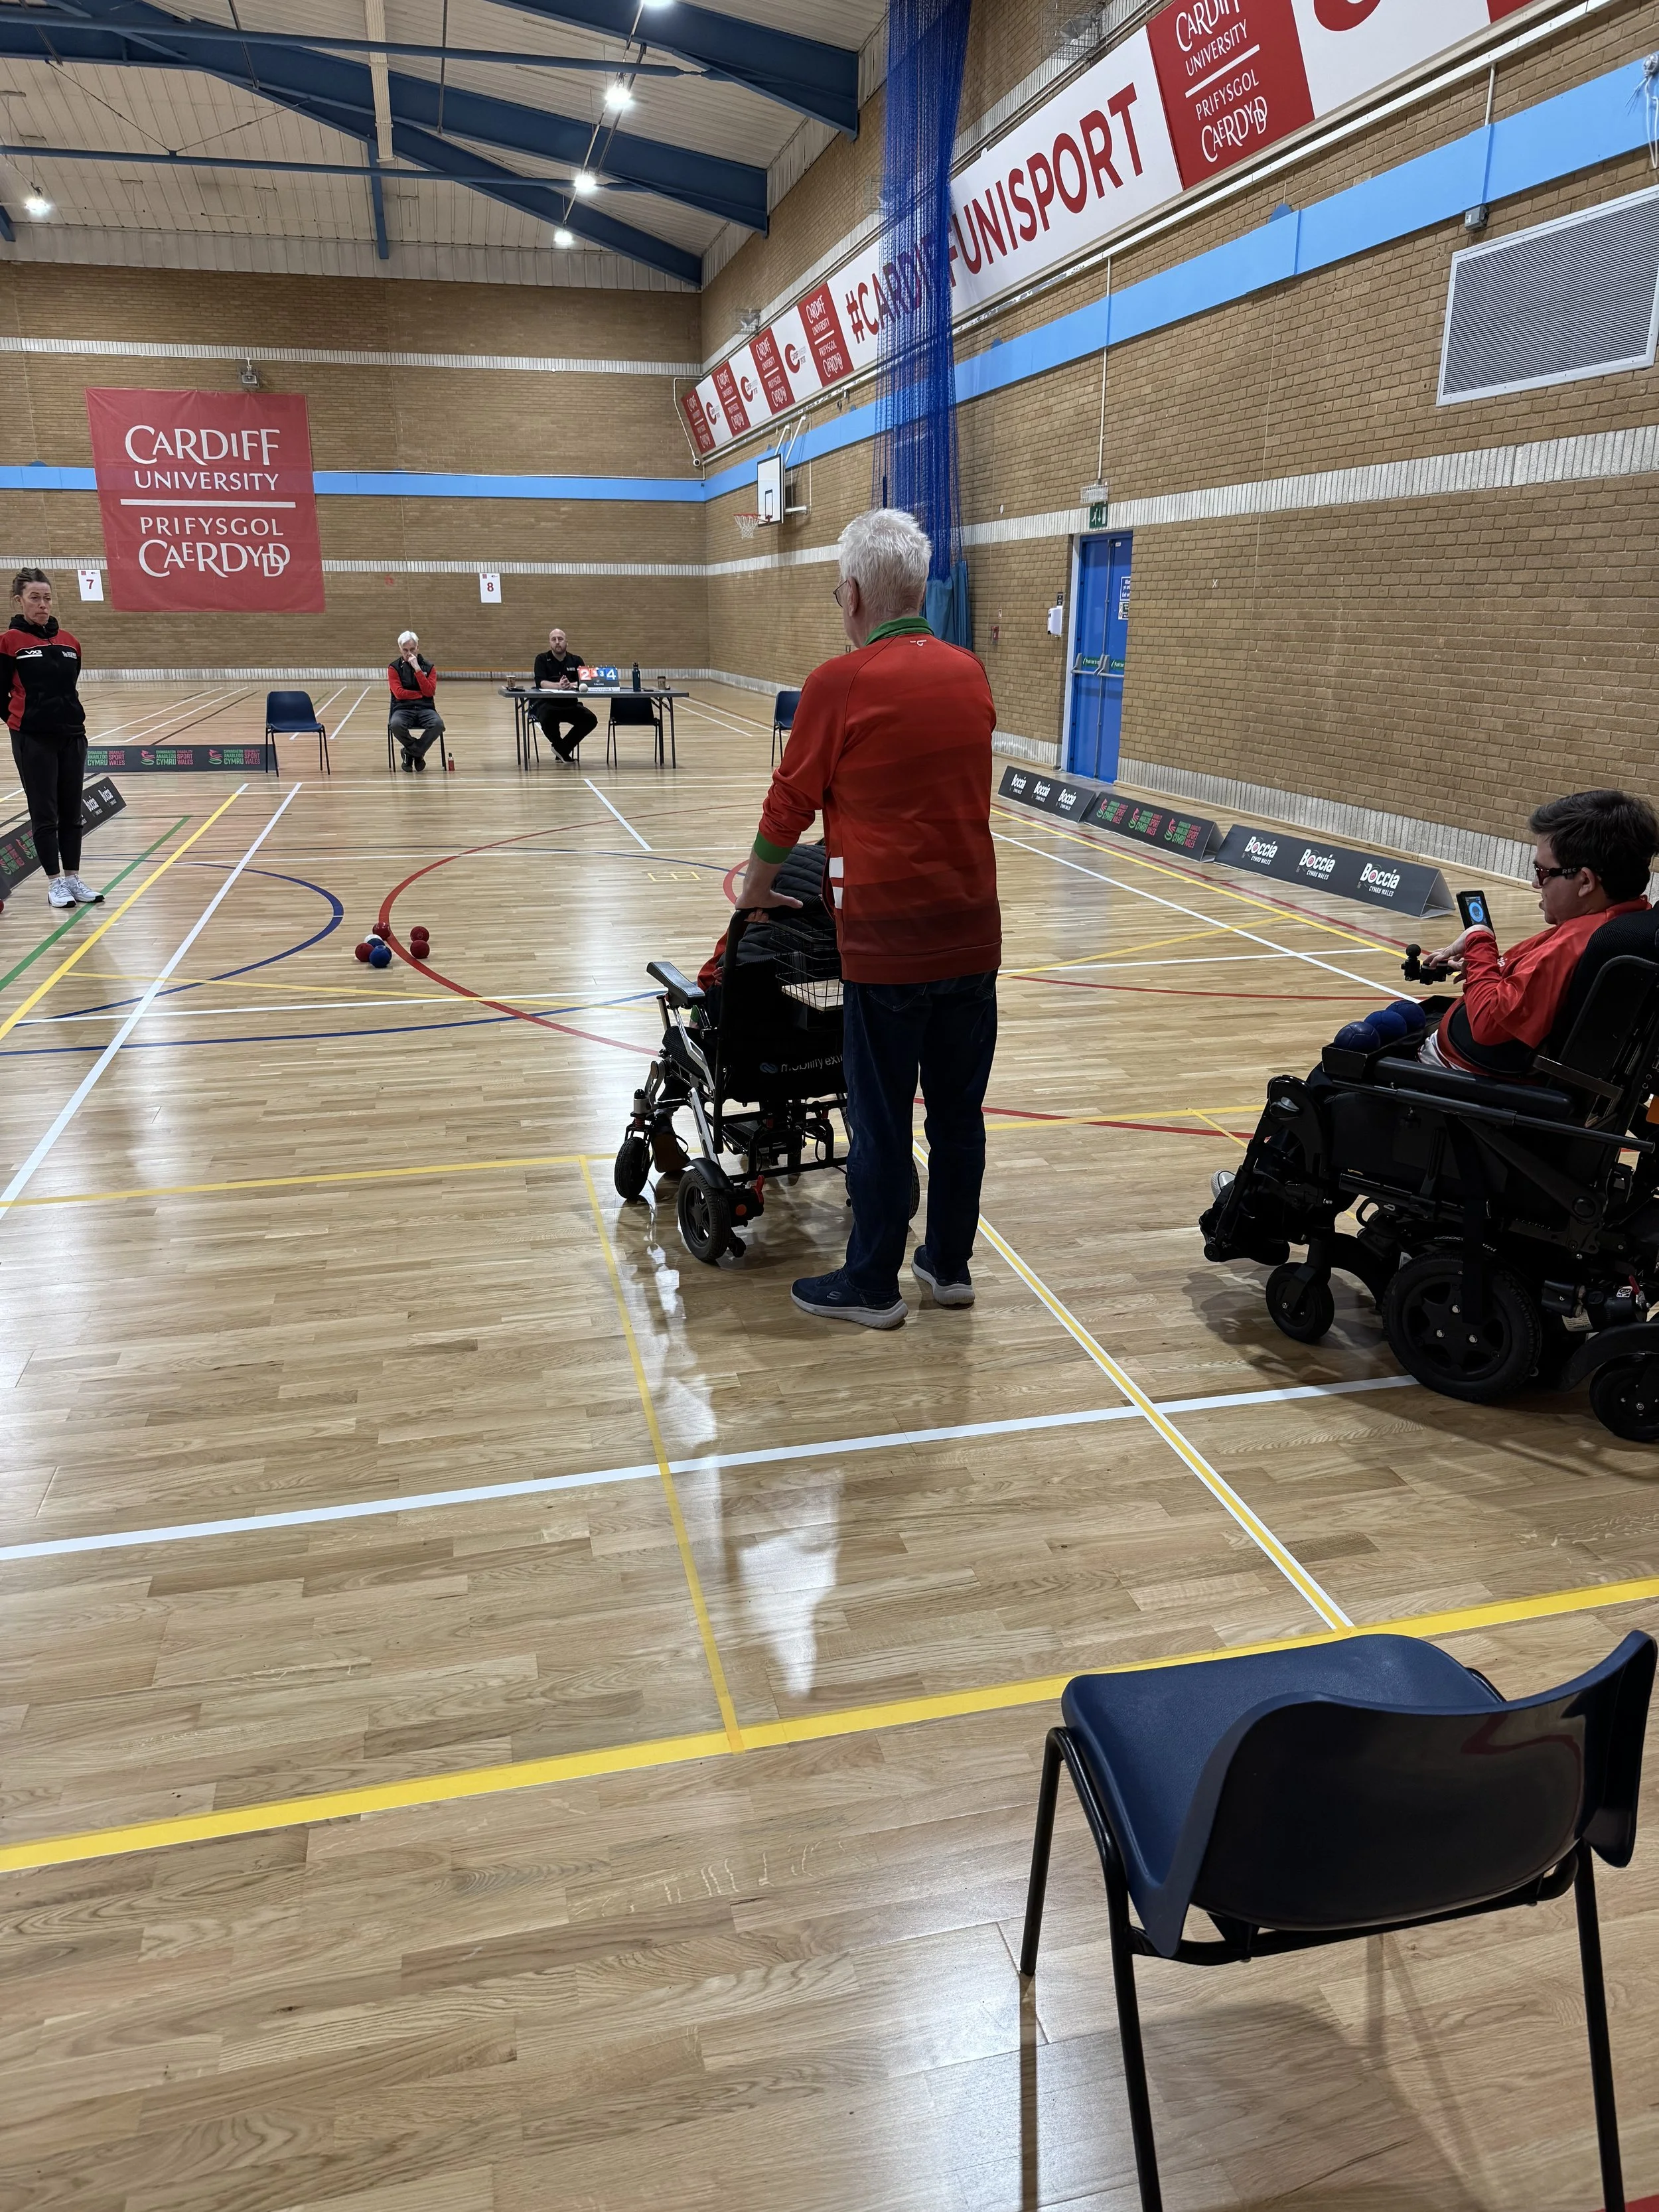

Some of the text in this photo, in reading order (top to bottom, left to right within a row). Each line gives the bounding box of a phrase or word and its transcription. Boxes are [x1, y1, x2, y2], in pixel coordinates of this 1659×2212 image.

[1185, 19, 1248, 77] UNIVERSITY
[1195, 68, 1260, 121] PRIFYSGOL
[806, 295, 826, 324] CARDIFF
[812, 317, 830, 336] UNIVERSITY
[756, 337, 771, 360] CARDIFF
[761, 356, 775, 371] UNIVERSITY
[125, 425, 280, 466] CARDIFF
[134, 471, 279, 491] UNIVERSITY
[140, 517, 283, 536] PRIFYSGOL
[86, 579, 94, 589] 7
[487, 582, 494, 592] 8
[580, 669, 591, 680] 2
[606, 669, 616, 680] 4
[1135, 822, 1148, 833] CYMRU
[1149, 818, 1160, 828] SPORT
[1172, 833, 1187, 846] CYMRU
[1185, 838, 1195, 848] WALES
[1187, 830, 1199, 840] SPORT
[1244, 836, 1278, 858] Boccia
[1299, 848, 1336, 873] Boccia
[1360, 863, 1400, 889] Boccia
[1369, 885, 1382, 895] CYMRU
